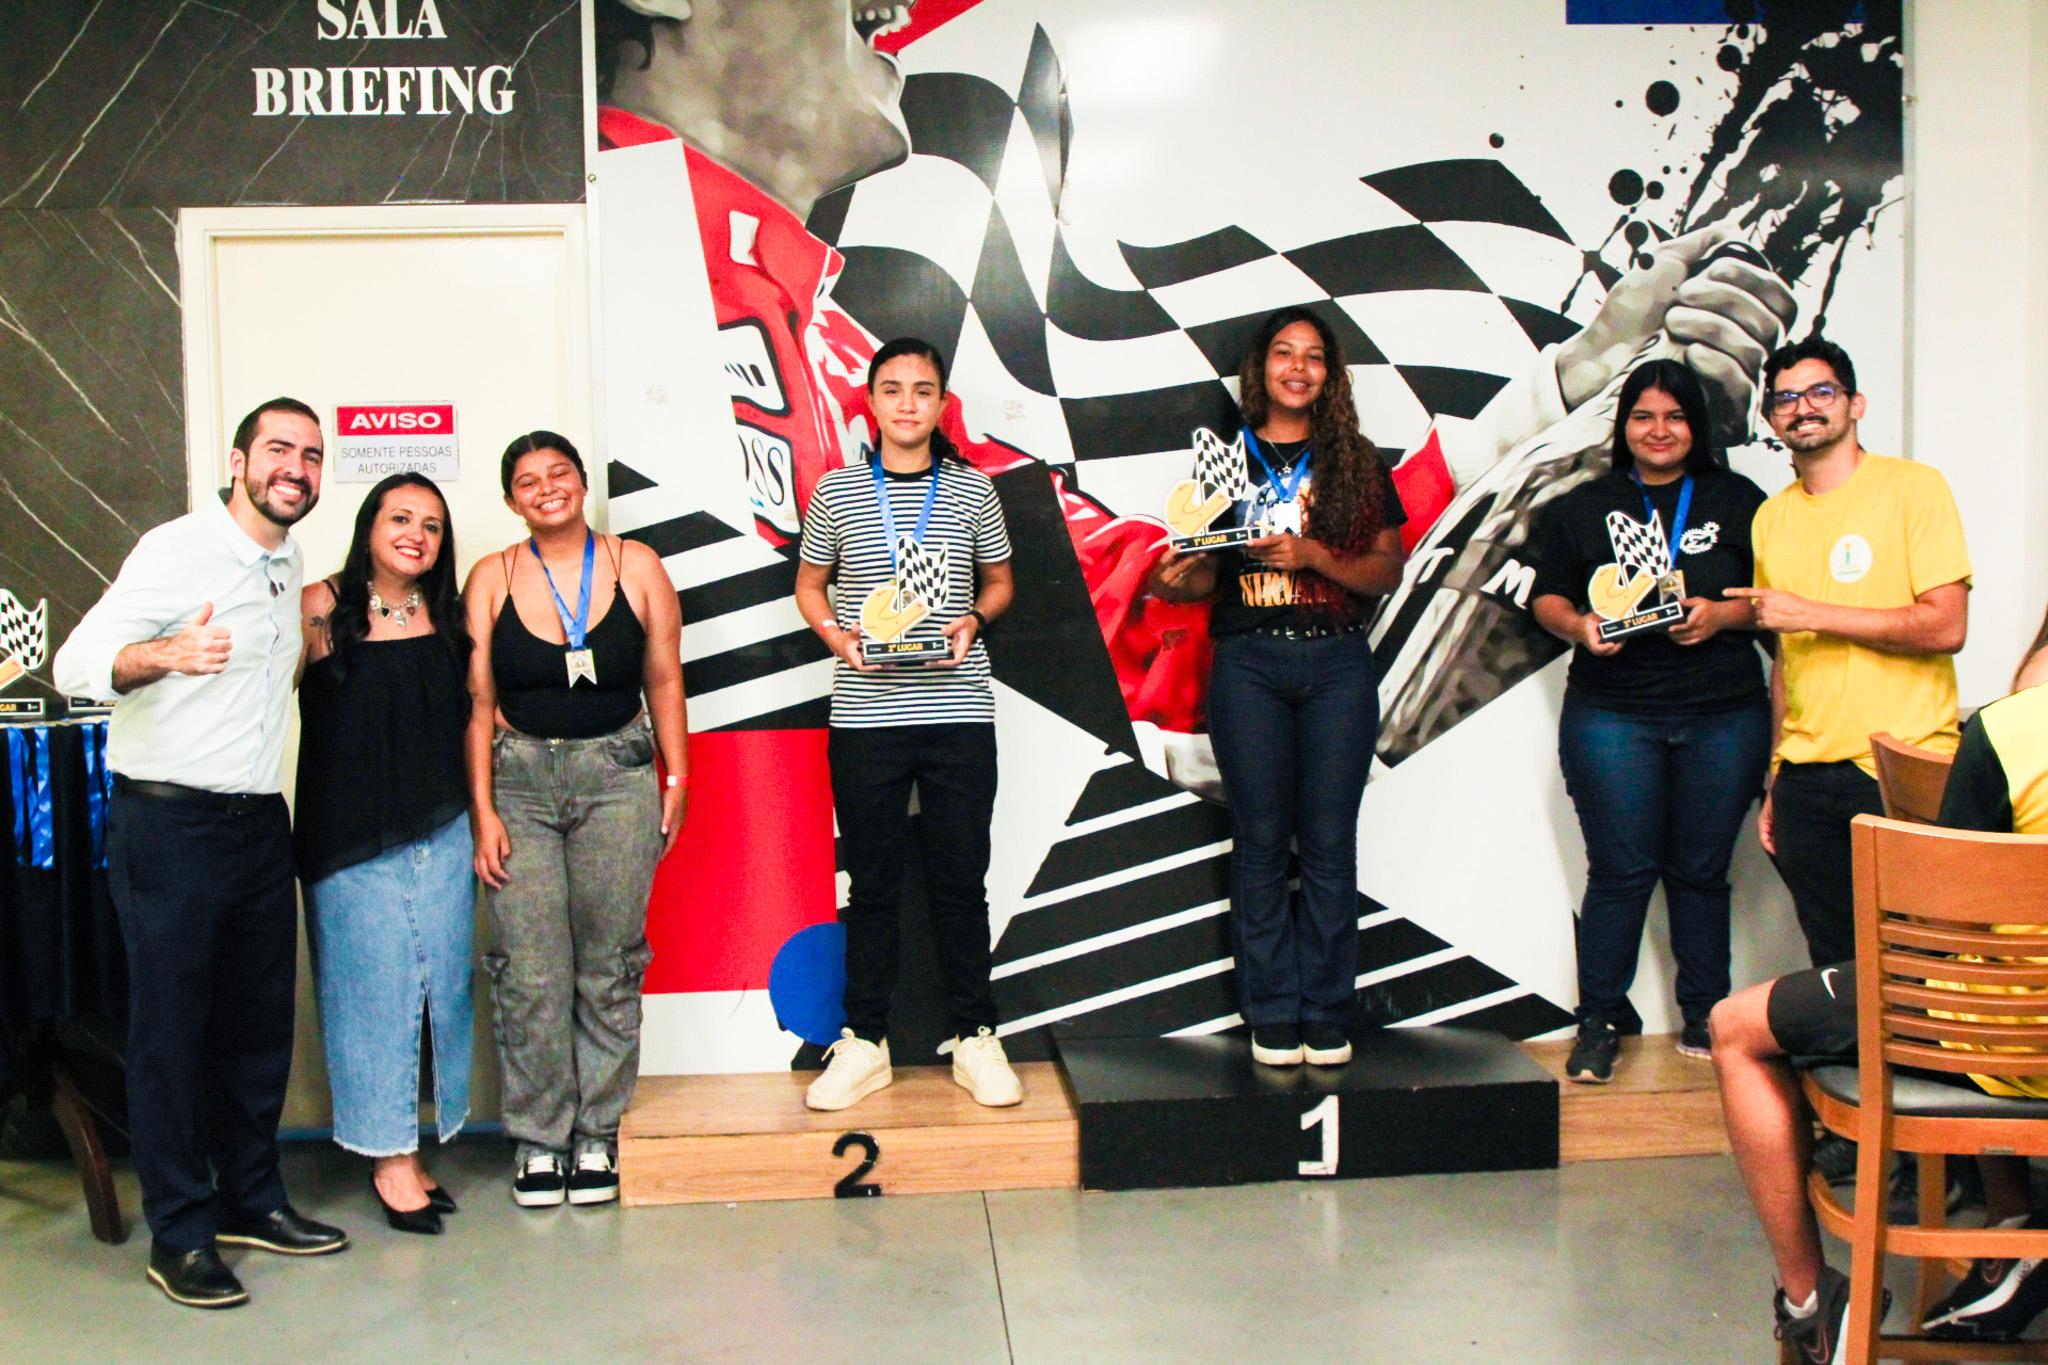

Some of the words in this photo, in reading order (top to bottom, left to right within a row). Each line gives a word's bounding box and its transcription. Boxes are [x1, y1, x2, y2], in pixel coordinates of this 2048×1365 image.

[317, 0, 447, 40] SALA
[251, 65, 516, 116] BRIEFING
[350, 412, 442, 429] AVISO
[341, 446, 396, 459] SOMENTE
[399, 445, 452, 457] PESSOAS
[358, 462, 437, 474] AUTORIZADAS
[1202, 534, 1228, 545] LUGAR
[1632, 613, 1659, 626] LUGAR
[897, 642, 923, 652] LUGAR
[1299, 1095, 1340, 1175] 1
[832, 1132, 882, 1199] 2
